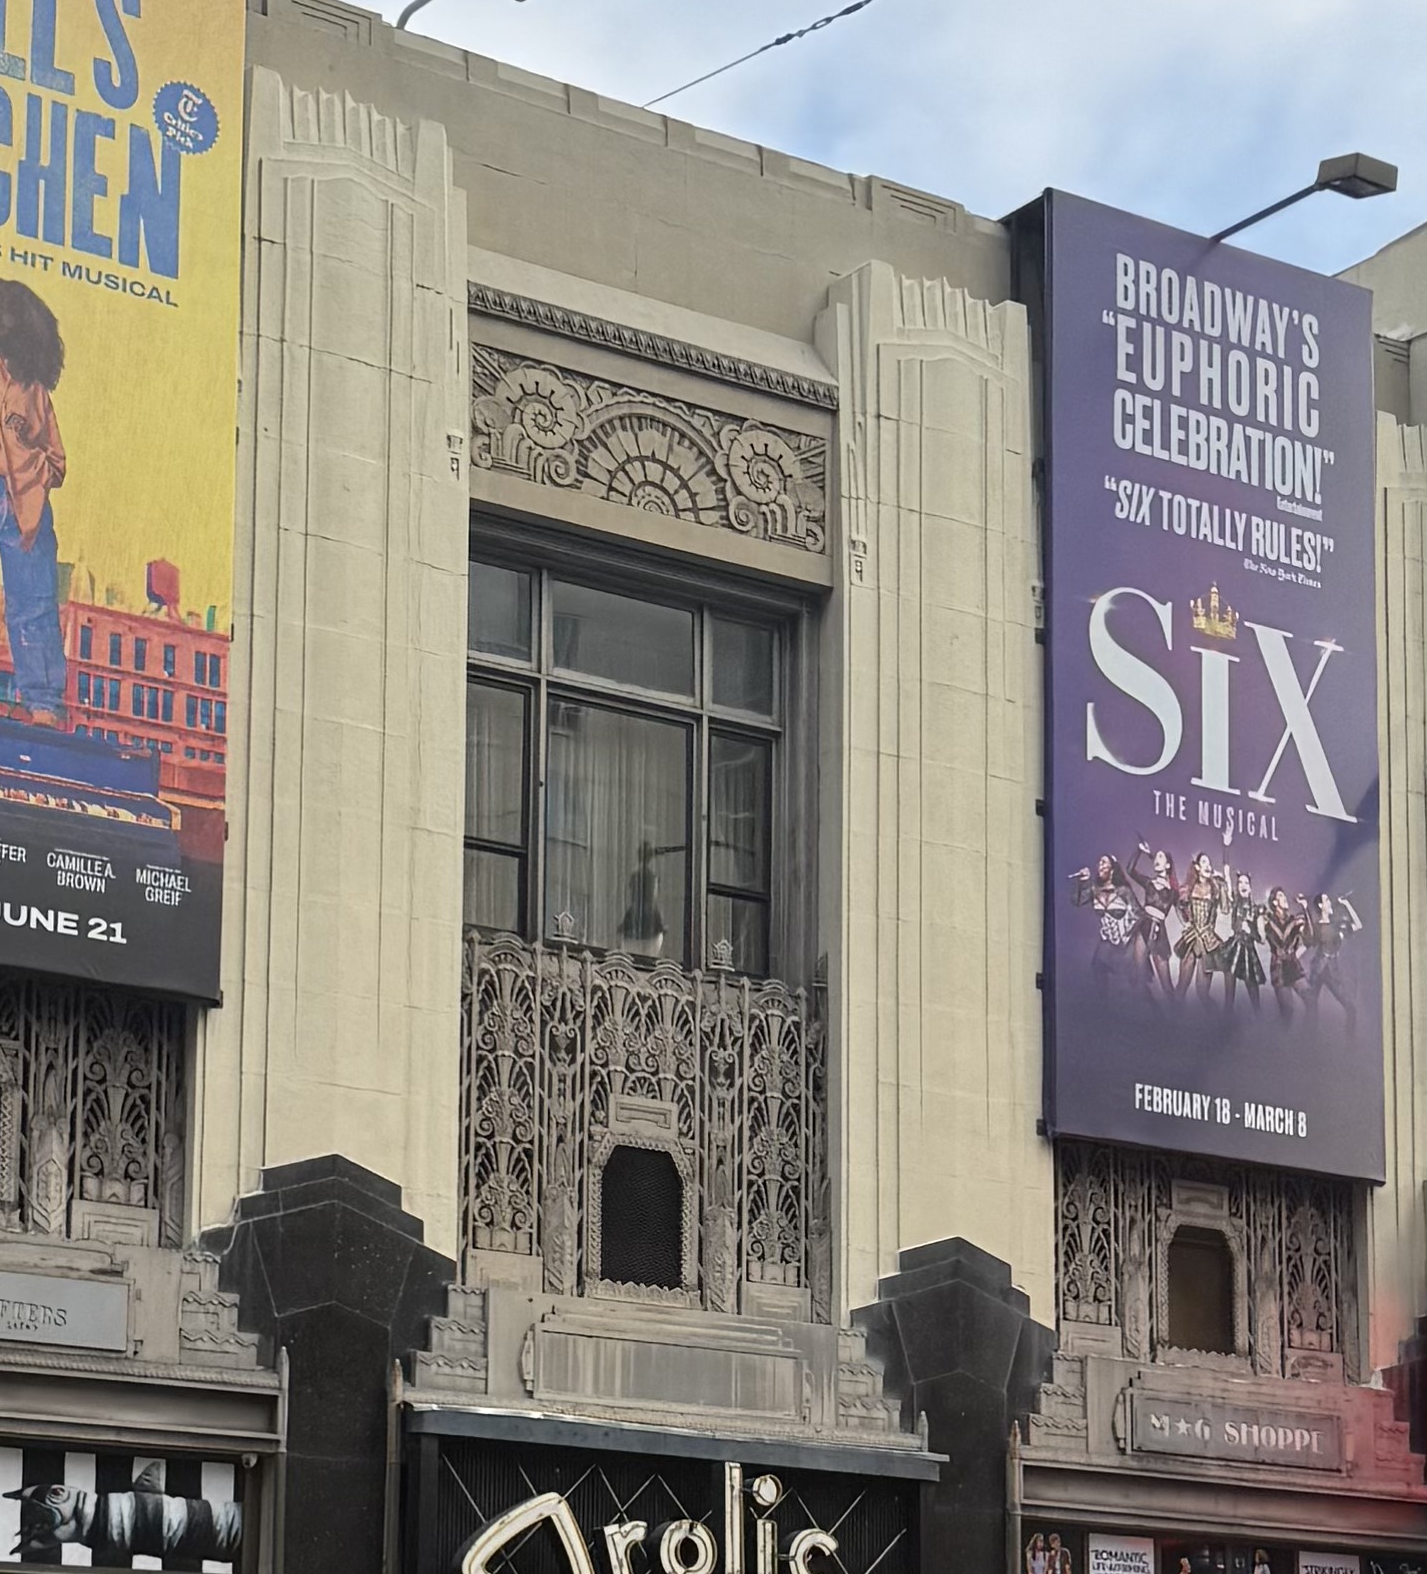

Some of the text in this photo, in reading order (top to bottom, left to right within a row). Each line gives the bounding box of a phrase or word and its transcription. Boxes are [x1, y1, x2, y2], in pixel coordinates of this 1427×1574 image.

[9, 246, 54, 272] HIT
[61, 261, 179, 307] MUSICAL
[1116, 253, 1319, 369] BROADWAY'S
[1159, 490, 1247, 552] TOTALLY
[1153, 789, 1279, 842] THE MUSICAL
[47, 852, 104, 877] CAMILLE
[136, 868, 192, 893] MICHAEL
[57, 870, 106, 894] BROWN
[145, 886, 182, 906] GREIF
[87, 918, 128, 944] 21
[1135, 1083, 1211, 1124] FEBRUARY
[1214, 1097, 1231, 1125] 18
[1244, 1102, 1293, 1136] MARCH
[1298, 1111, 1307, 1137] 8
[1224, 1422, 1324, 1455] SHOPPE
